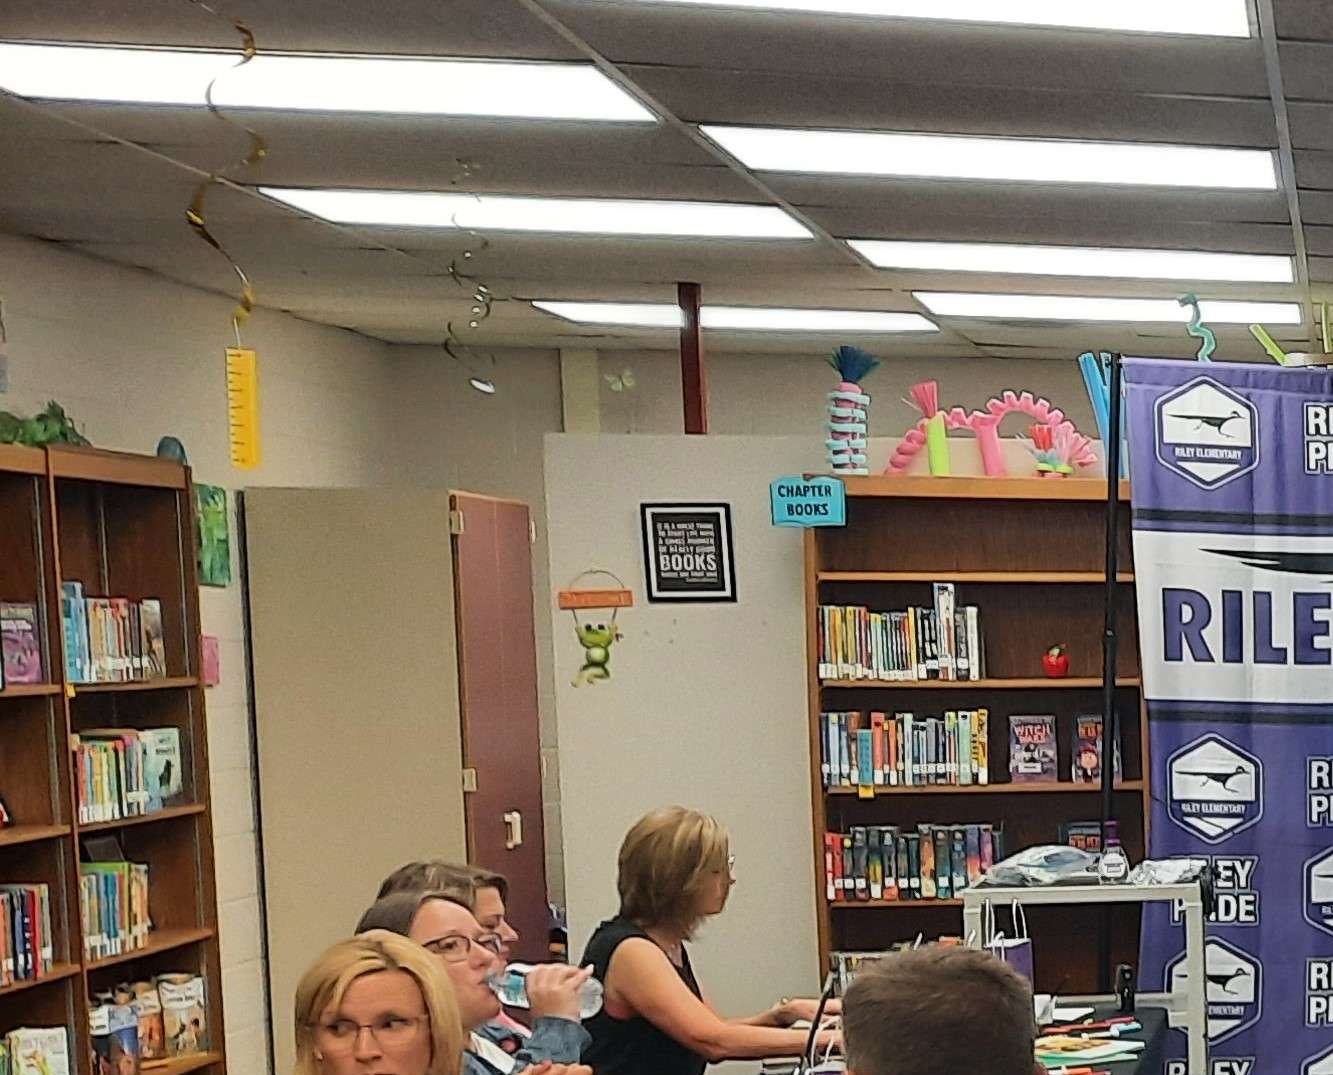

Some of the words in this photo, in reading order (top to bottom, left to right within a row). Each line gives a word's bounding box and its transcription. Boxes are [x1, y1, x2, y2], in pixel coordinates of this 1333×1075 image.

[1174, 447, 1195, 459] RILEY
[1196, 447, 1243, 459] ELEMENTARY
[777, 485, 832, 497] CHAPTER
[786, 503, 829, 516] BOOKS
[660, 554, 717, 571] BOOKS
[1173, 894, 1256, 922] PDE
[1208, 1005, 1245, 1015] EMENTARY
